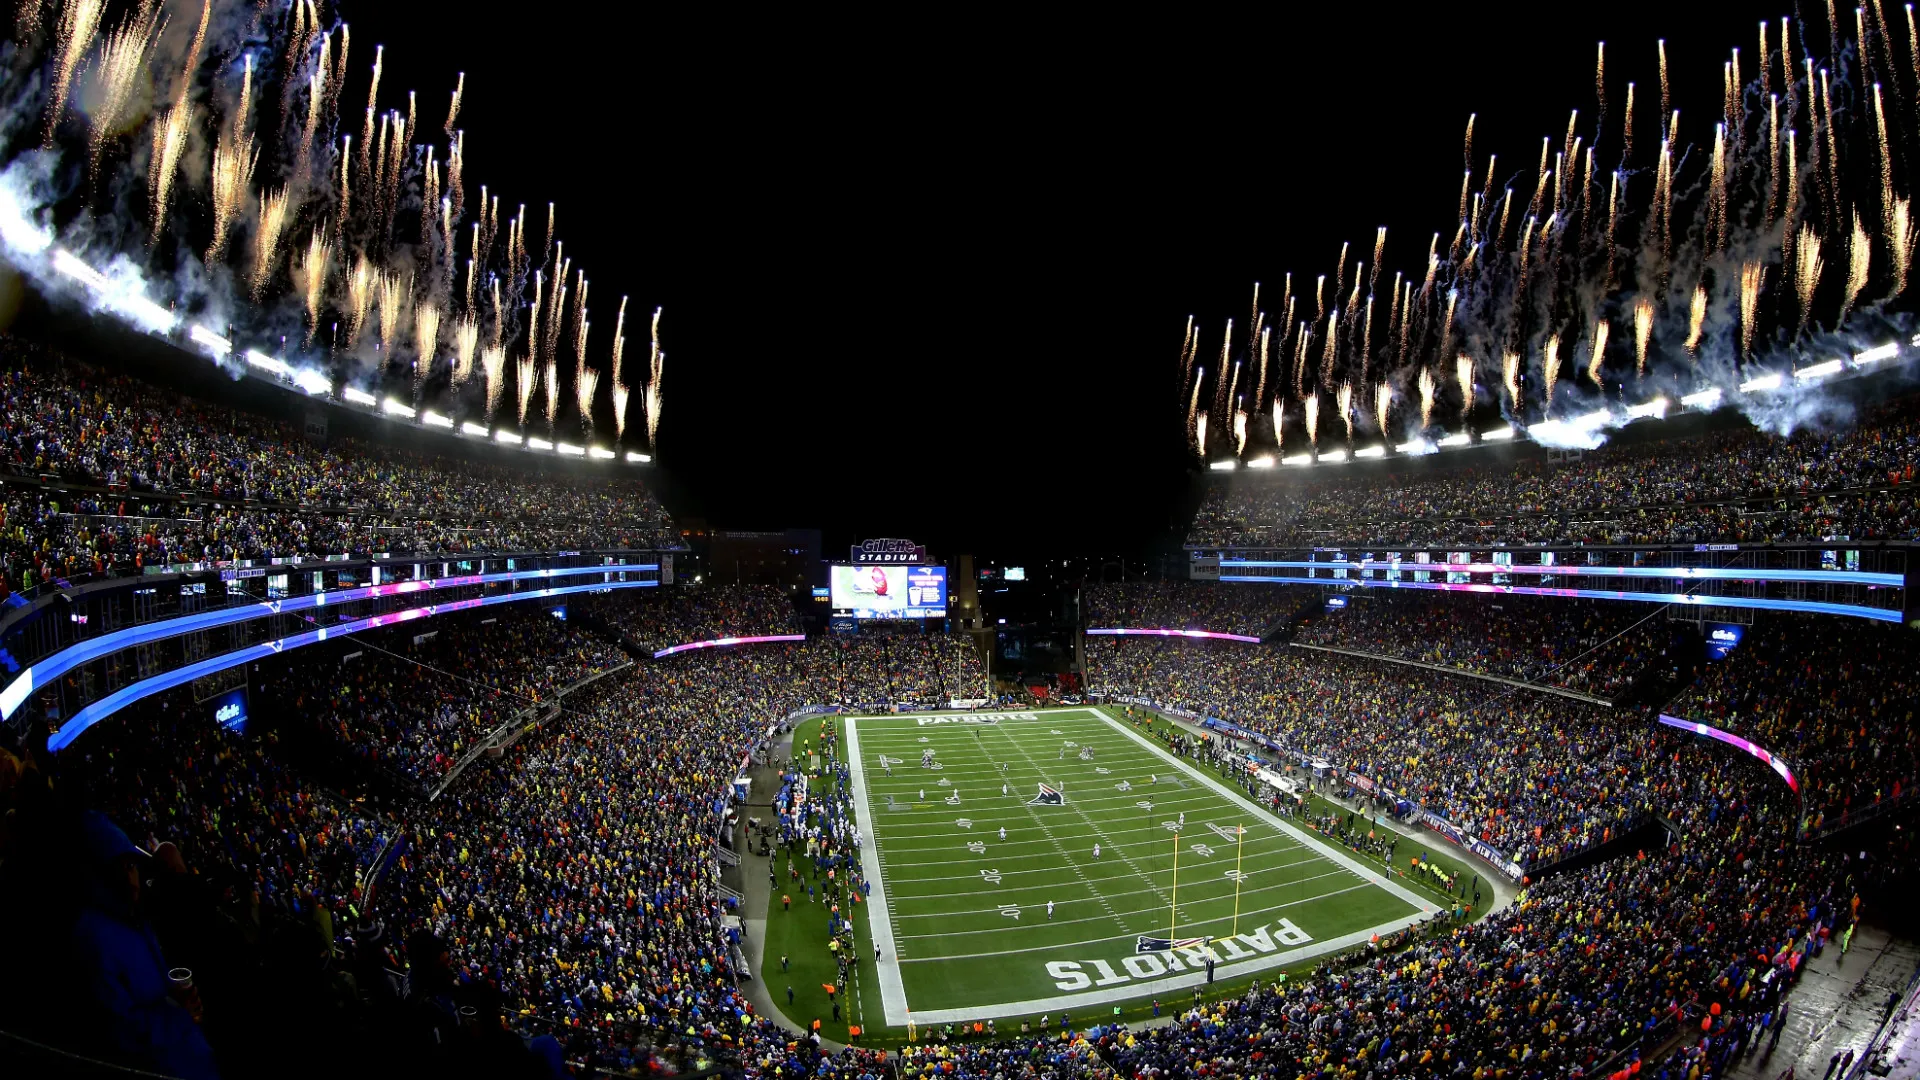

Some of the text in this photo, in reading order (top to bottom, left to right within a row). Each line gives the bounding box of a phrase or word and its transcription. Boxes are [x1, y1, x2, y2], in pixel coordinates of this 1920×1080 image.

[861, 538, 916, 553] Gillette
[917, 713, 1038, 726] PATRIOTS
[1475, 842, 1491, 858] NEW
[979, 868, 1002, 882] 20
[997, 903, 1021, 917] 10
[1044, 917, 1314, 992] PATRIOTS
